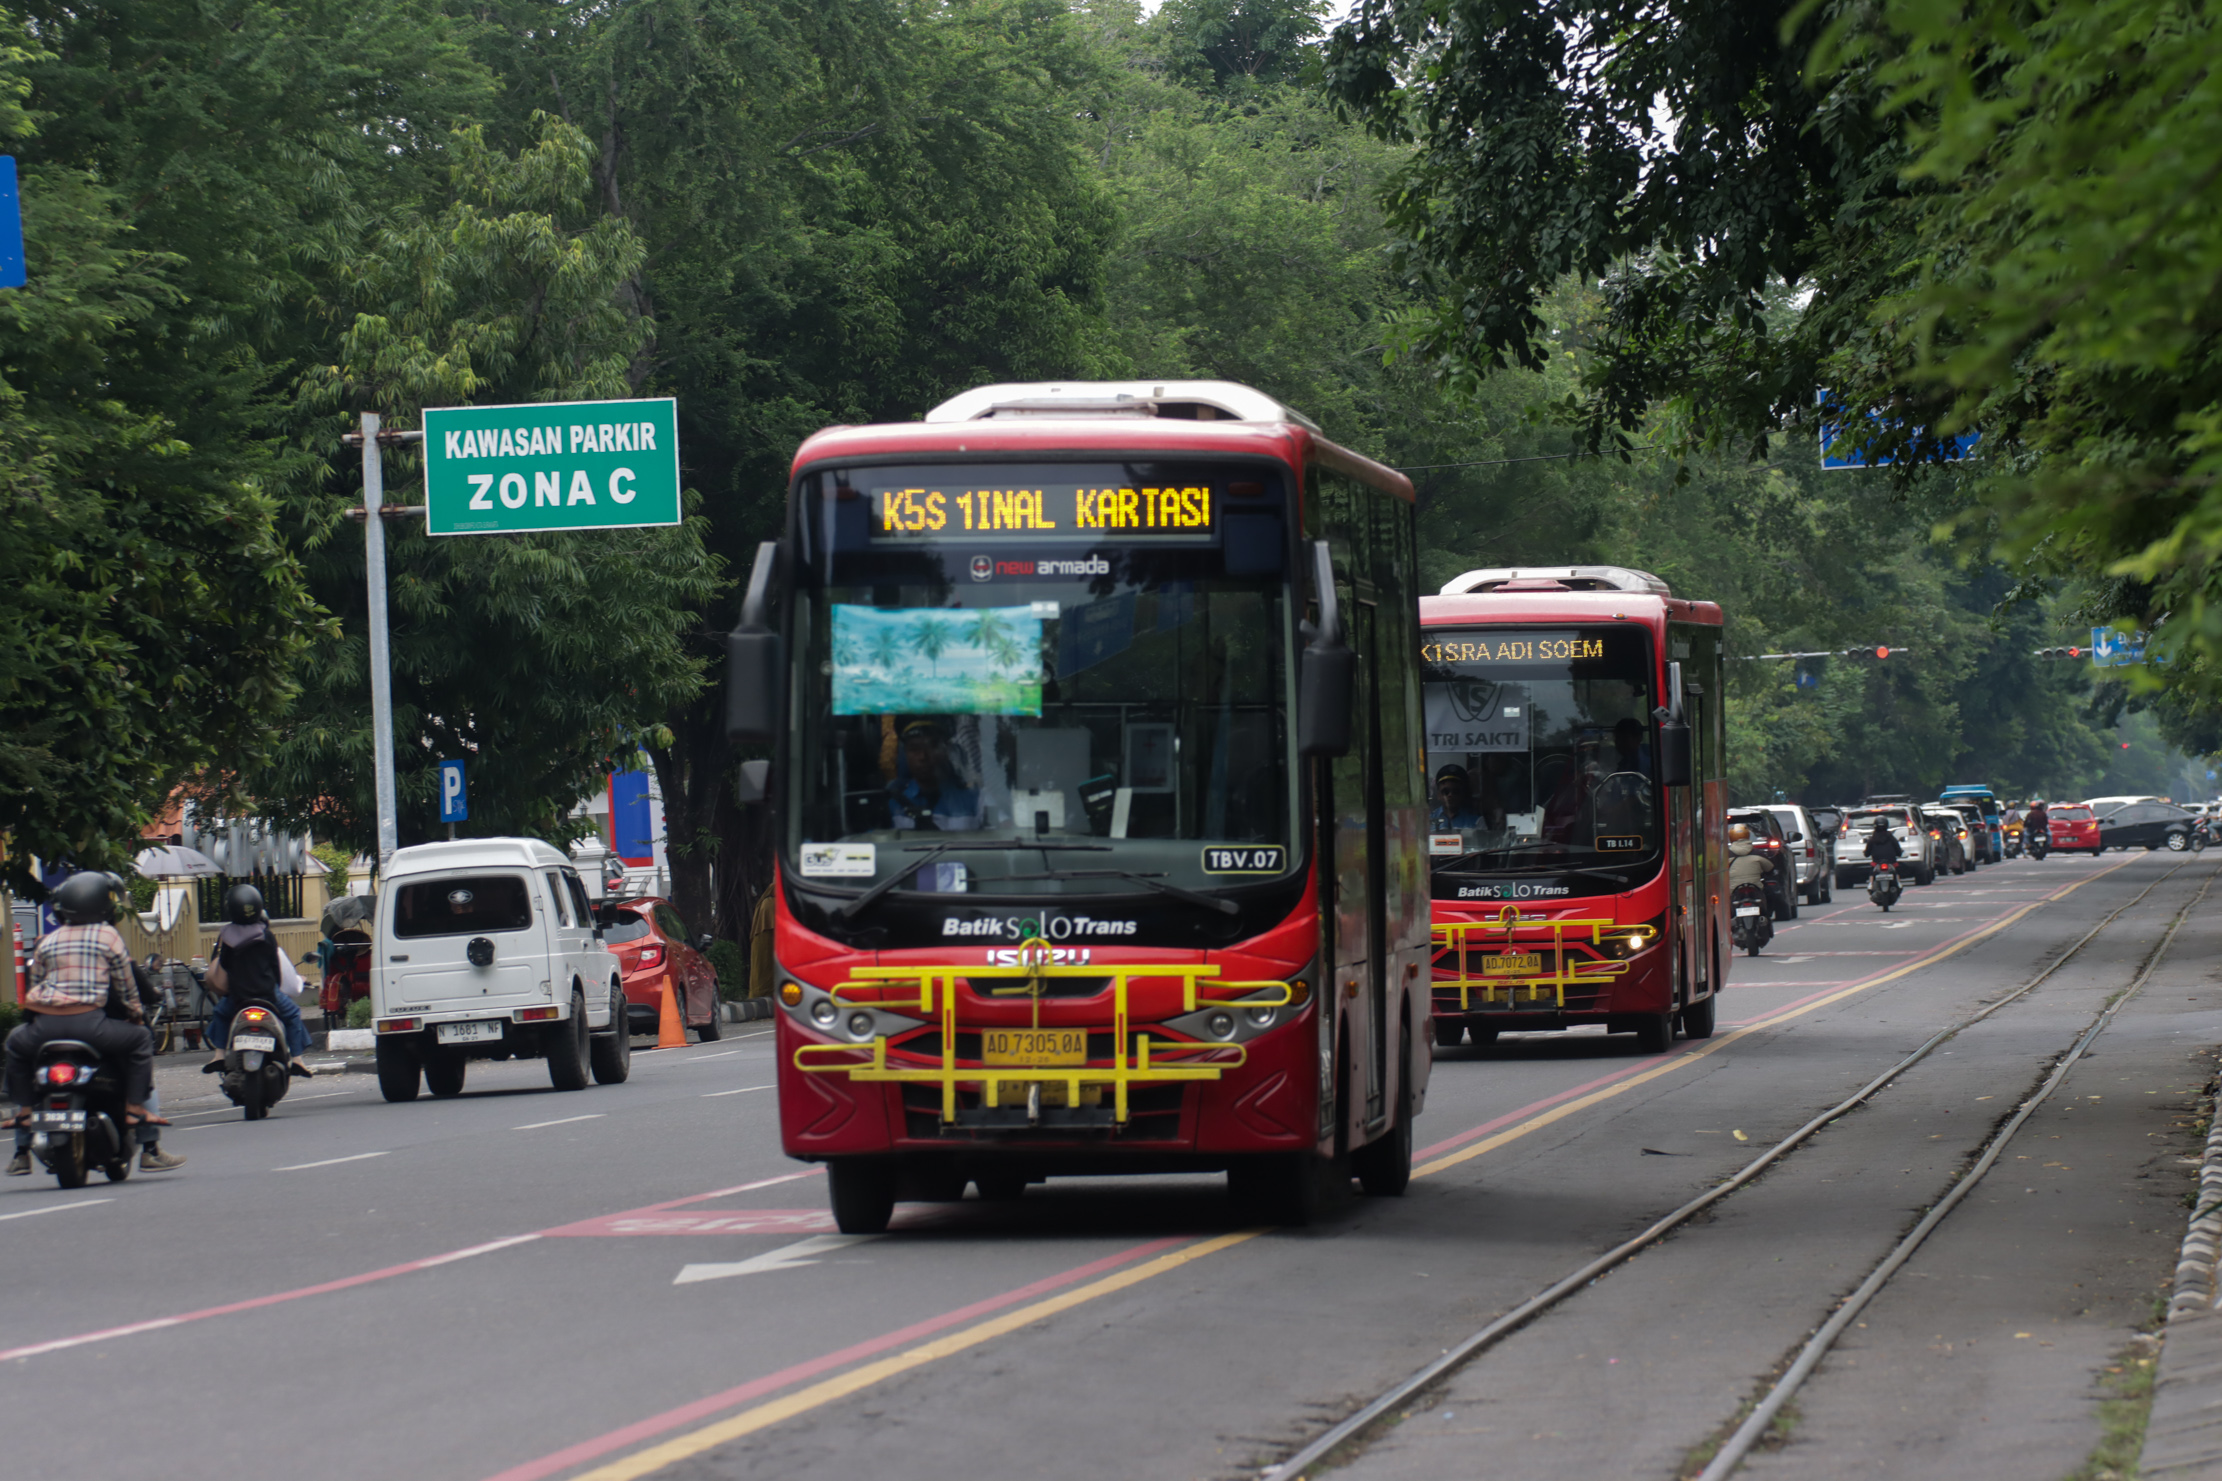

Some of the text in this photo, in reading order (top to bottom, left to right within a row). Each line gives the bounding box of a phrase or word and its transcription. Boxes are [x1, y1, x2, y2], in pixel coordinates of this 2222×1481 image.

[445, 422, 657, 459] KAWASAN PARKIR
[467, 467, 637, 510] ZONA C
[995, 554, 1110, 575] new armada
[1496, 641, 1533, 660] ADI
[1538, 639, 1603, 659] SOEM
[1431, 732, 1520, 747] TRI SAKTI
[444, 766, 461, 815] P
[1210, 851, 1278, 868] TBV.07
[1457, 886, 1493, 898] Batik
[1532, 885, 1570, 895] Trans
[942, 917, 1003, 936] Batik
[1073, 917, 1137, 935] Trans
[1486, 958, 1498, 969] AD
[438, 1021, 501, 1038] N 1681 NF
[987, 1033, 1008, 1054] AD
[1013, 1033, 1057, 1054] 7305
